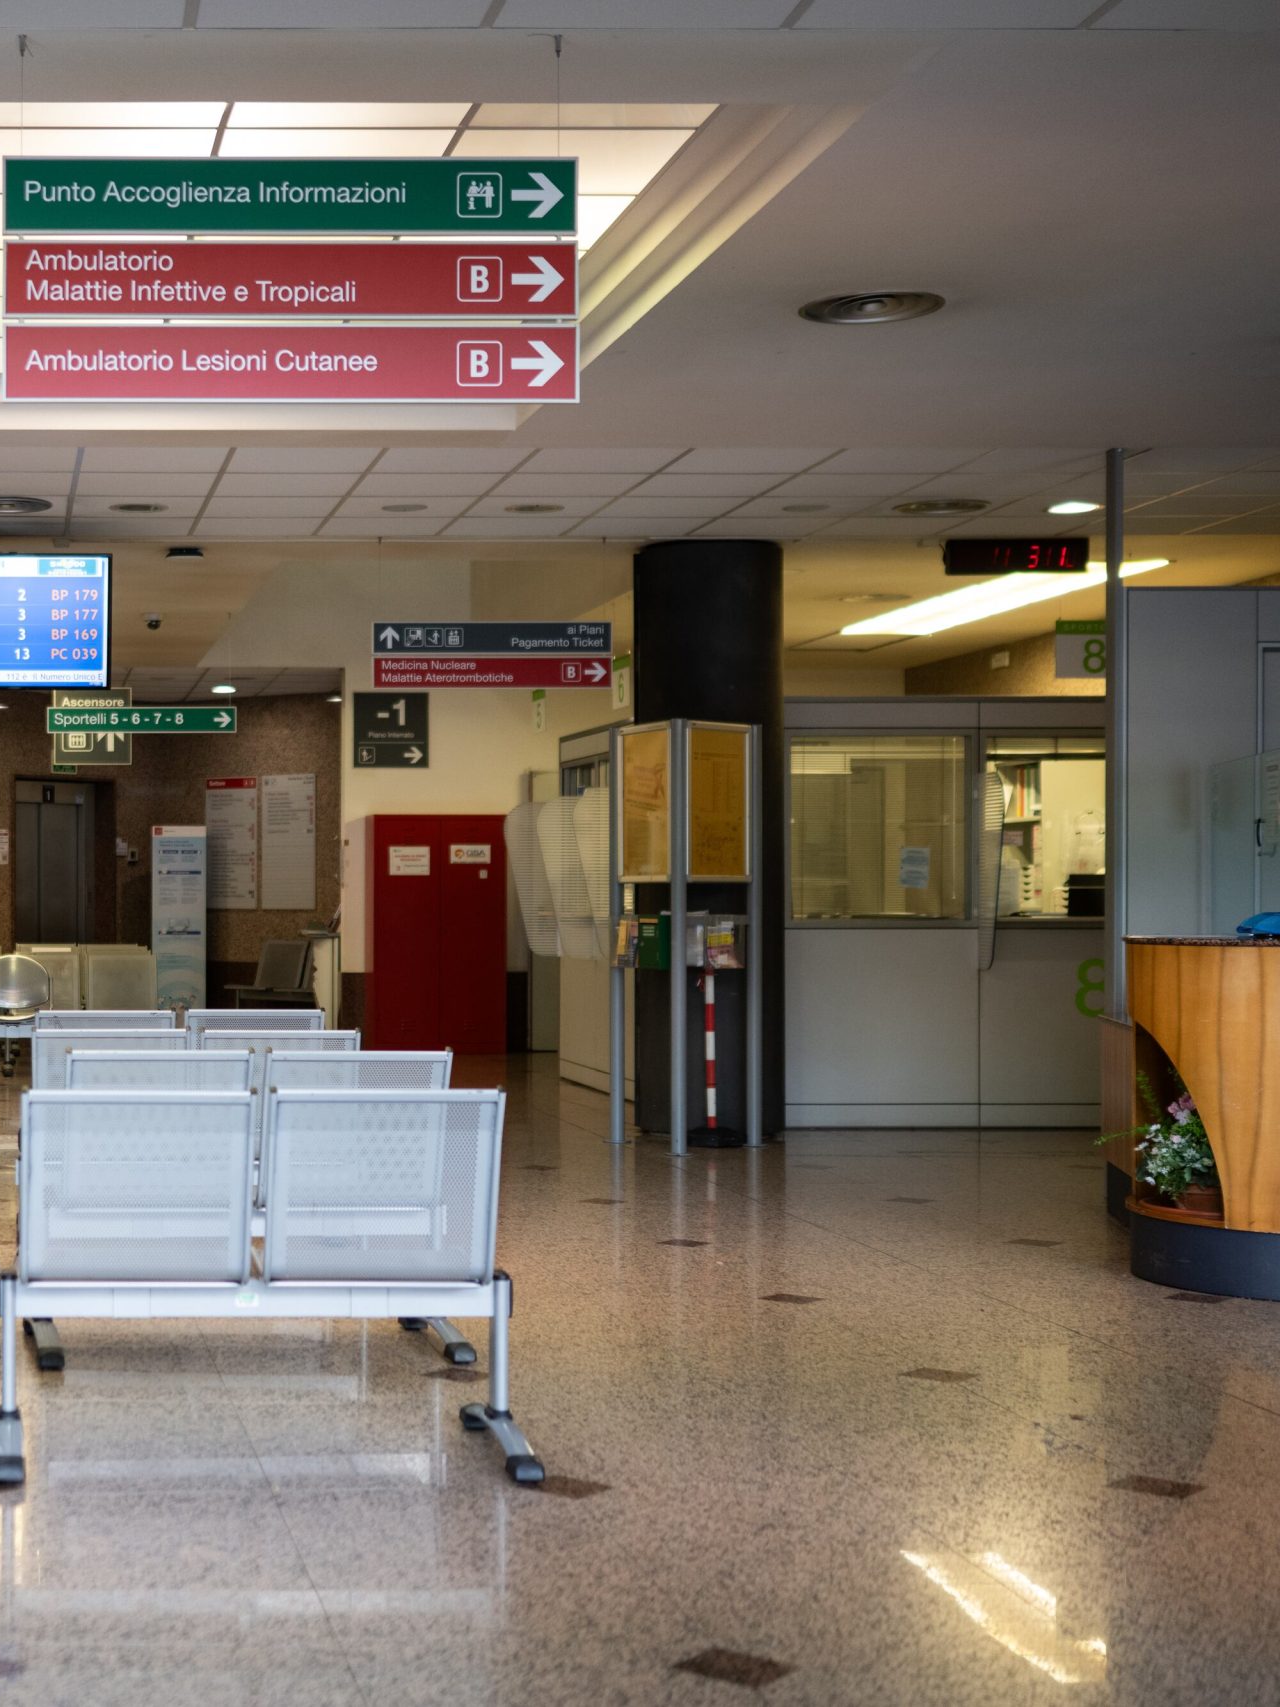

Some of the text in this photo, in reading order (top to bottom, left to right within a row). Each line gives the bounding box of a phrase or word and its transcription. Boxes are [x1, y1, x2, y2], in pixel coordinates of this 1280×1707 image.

[25, 181, 405, 207] Punto Accoglienza Informazioni
[26, 250, 173, 271] Ambulatorio
[471, 266, 489, 293] B
[27, 280, 355, 307] Malattie Infettive e Tropicali
[25, 350, 377, 371] Ambulatorio Lesioni Cutanee
[470, 350, 489, 377] B
[18, 589, 98, 601] 2 BP 179
[18, 609, 98, 621] 3 BP 177
[18, 629, 97, 640] 3 BP 169
[568, 625, 604, 634] ai Piani
[512, 637, 603, 649] Pagamento Ticket
[14, 648, 97, 660] 13 PC 039
[1083, 640, 1104, 673] 8
[382, 661, 476, 670] Medicina Nucleare
[382, 673, 513, 682] Malattie Aterotrombotiche
[567, 667, 575, 678] B
[62, 697, 124, 707] Ascensore
[54, 713, 106, 727] Sportelli
[111, 714, 118, 724] 5
[132, 714, 140, 724] 6
[154, 714, 161, 724] 7
[176, 714, 184, 724] 8
